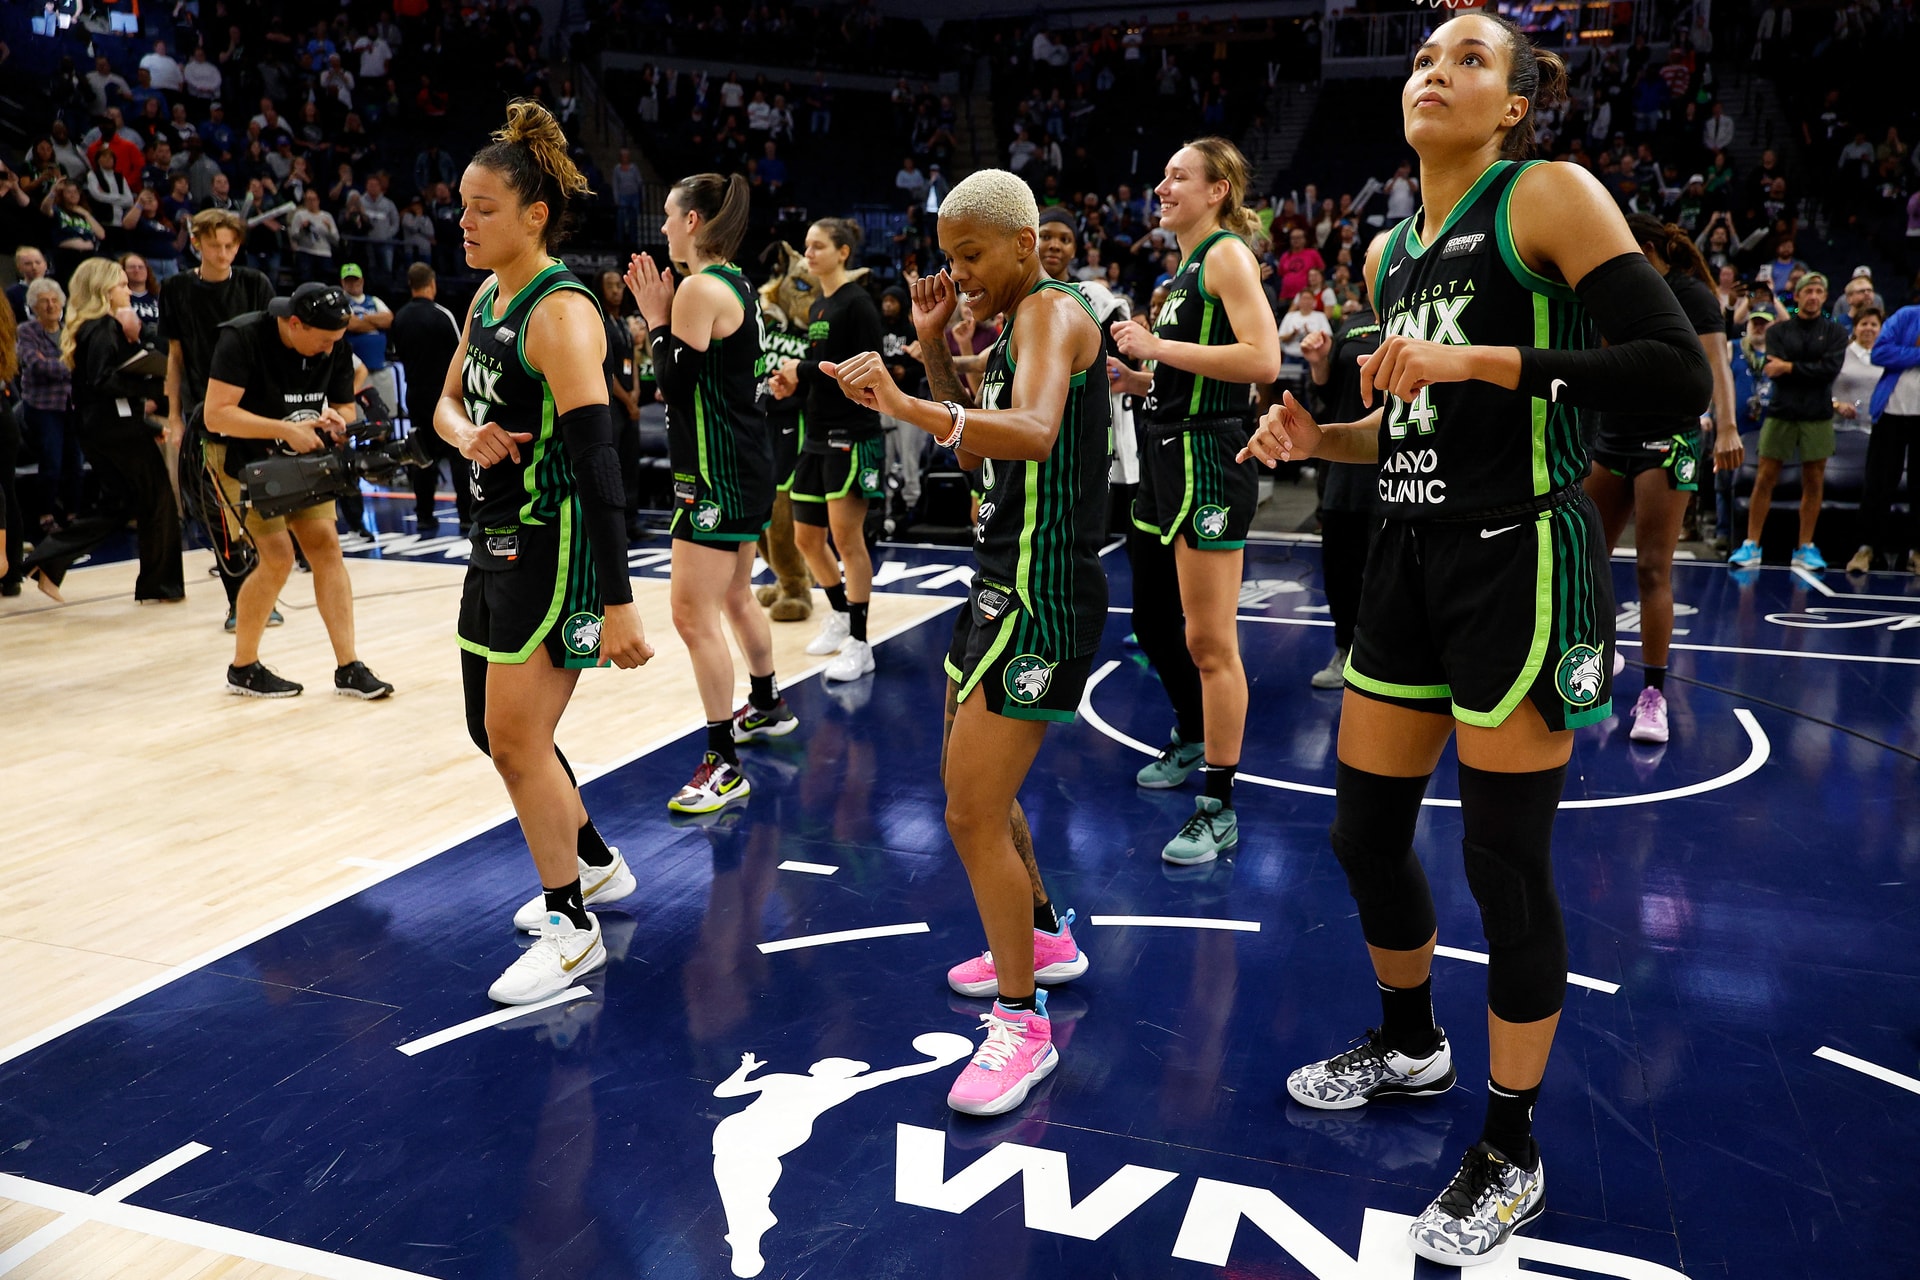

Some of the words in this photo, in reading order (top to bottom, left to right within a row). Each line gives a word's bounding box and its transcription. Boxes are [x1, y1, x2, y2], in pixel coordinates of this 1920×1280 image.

[1383, 295, 1475, 346] YNX
[284, 394, 303, 403] VIDEO
[304, 392, 324, 403] CREW
[1379, 479, 1446, 504] CLINIC
